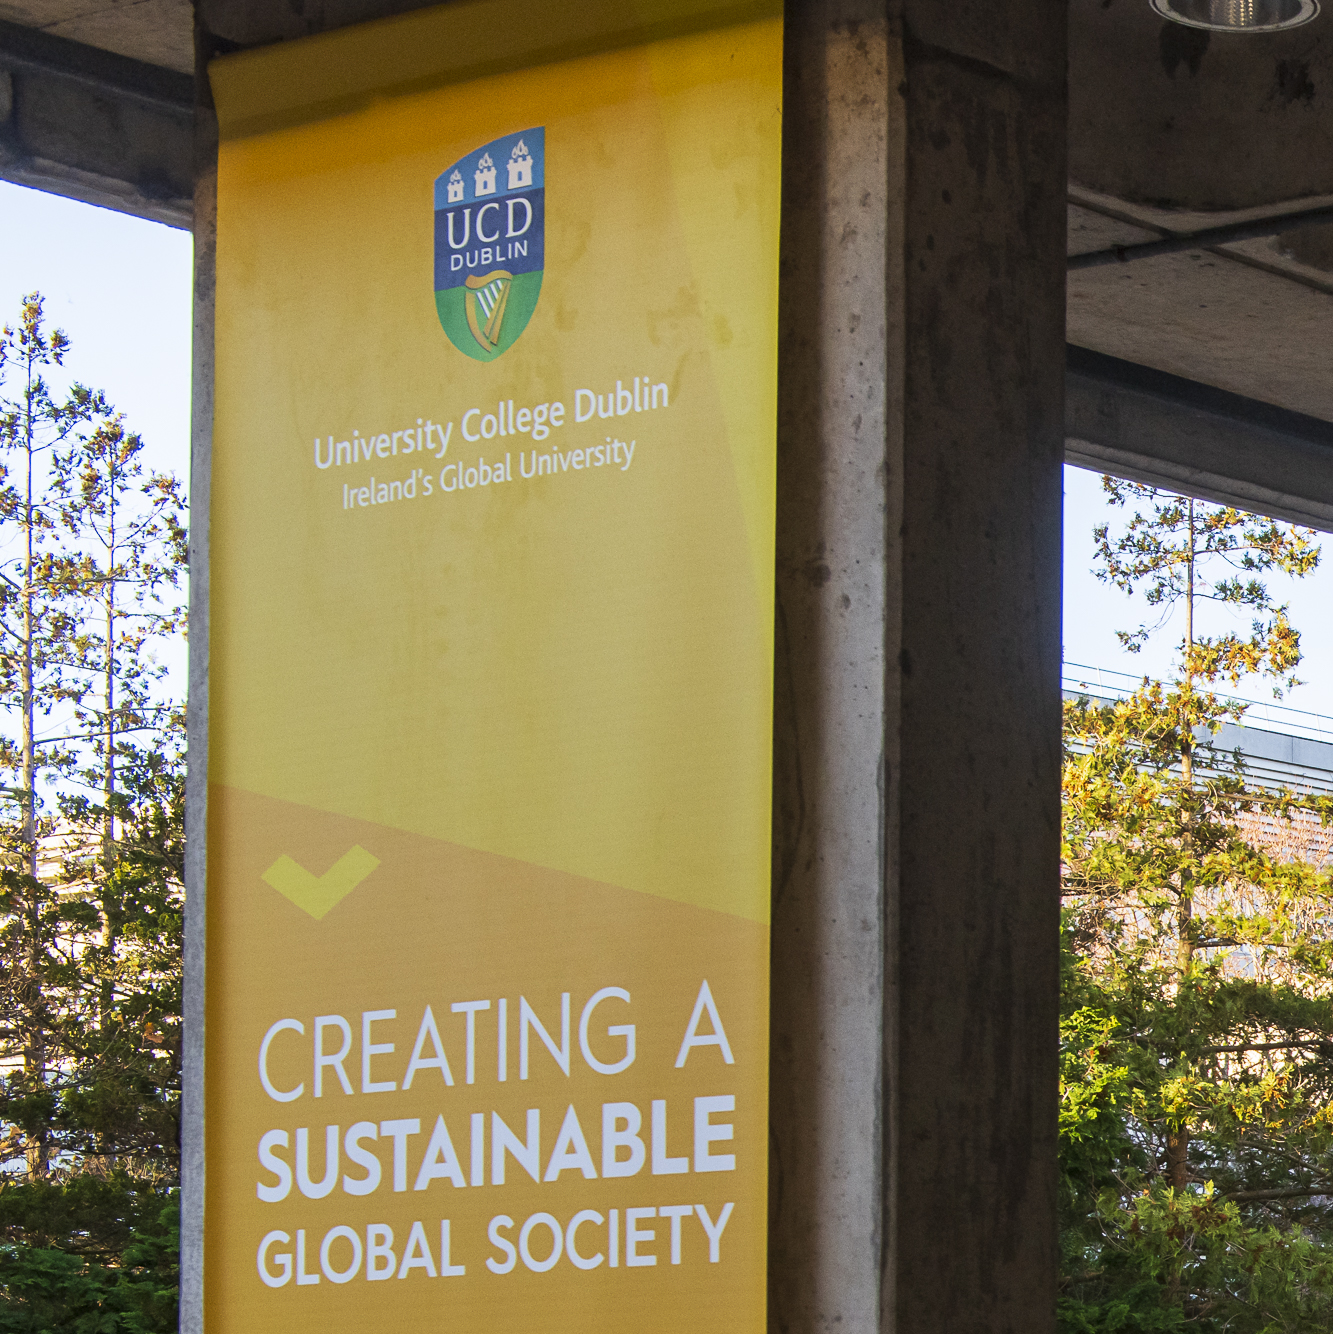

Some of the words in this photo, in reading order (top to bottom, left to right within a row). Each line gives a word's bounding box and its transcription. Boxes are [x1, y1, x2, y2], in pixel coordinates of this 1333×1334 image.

[446, 197, 533, 249] UCD
[450, 240, 528, 271] DUBLIN
[313, 419, 453, 469] University
[461, 399, 565, 441] College
[574, 376, 669, 423] Dublin
[342, 470, 433, 510] Ireland's
[440, 452, 512, 493] Global
[520, 438, 637, 479] University
[258, 986, 638, 1103] CREATING
[674, 978, 736, 1069] A
[256, 1094, 737, 1203] SUSTAINABLE
[256, 1219, 466, 1288] GLOBAL
[485, 1202, 736, 1275] SOCIETY
